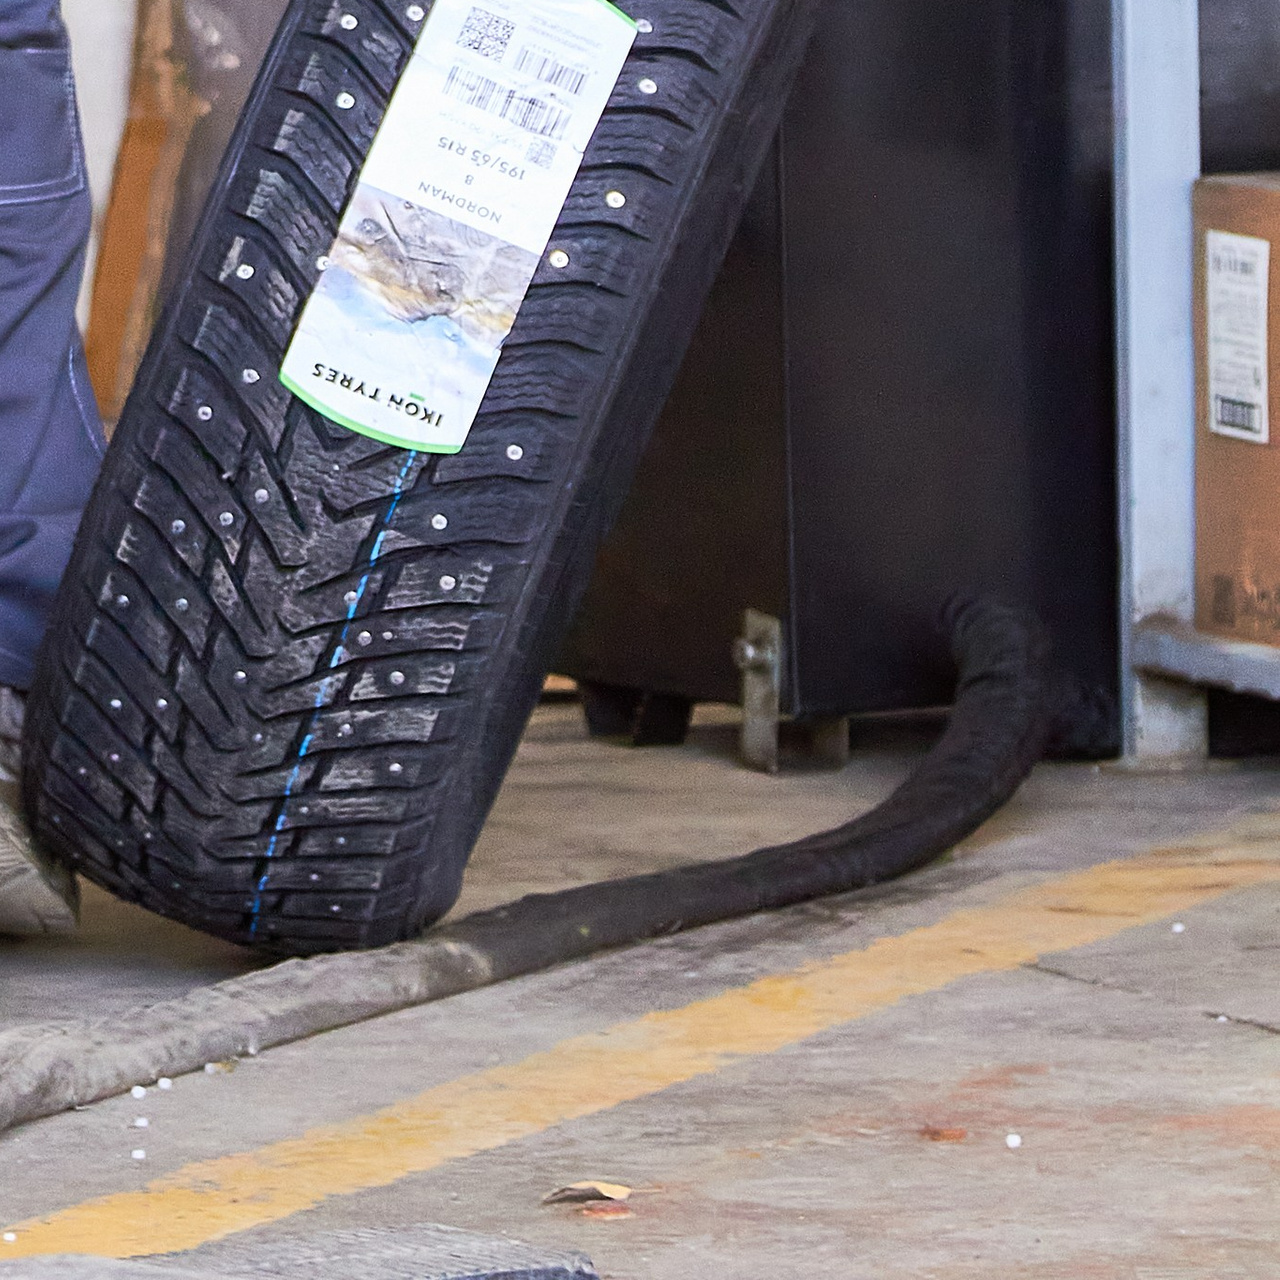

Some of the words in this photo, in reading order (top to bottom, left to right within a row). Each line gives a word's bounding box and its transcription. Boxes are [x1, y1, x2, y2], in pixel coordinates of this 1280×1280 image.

[438, 136, 467, 156] R15
[464, 174, 474, 185] 8
[470, 149, 525, 180] 195/65
[418, 181, 502, 224] NORDMAN
[312, 363, 381, 402] TYRES
[387, 393, 443, 427] IKON
